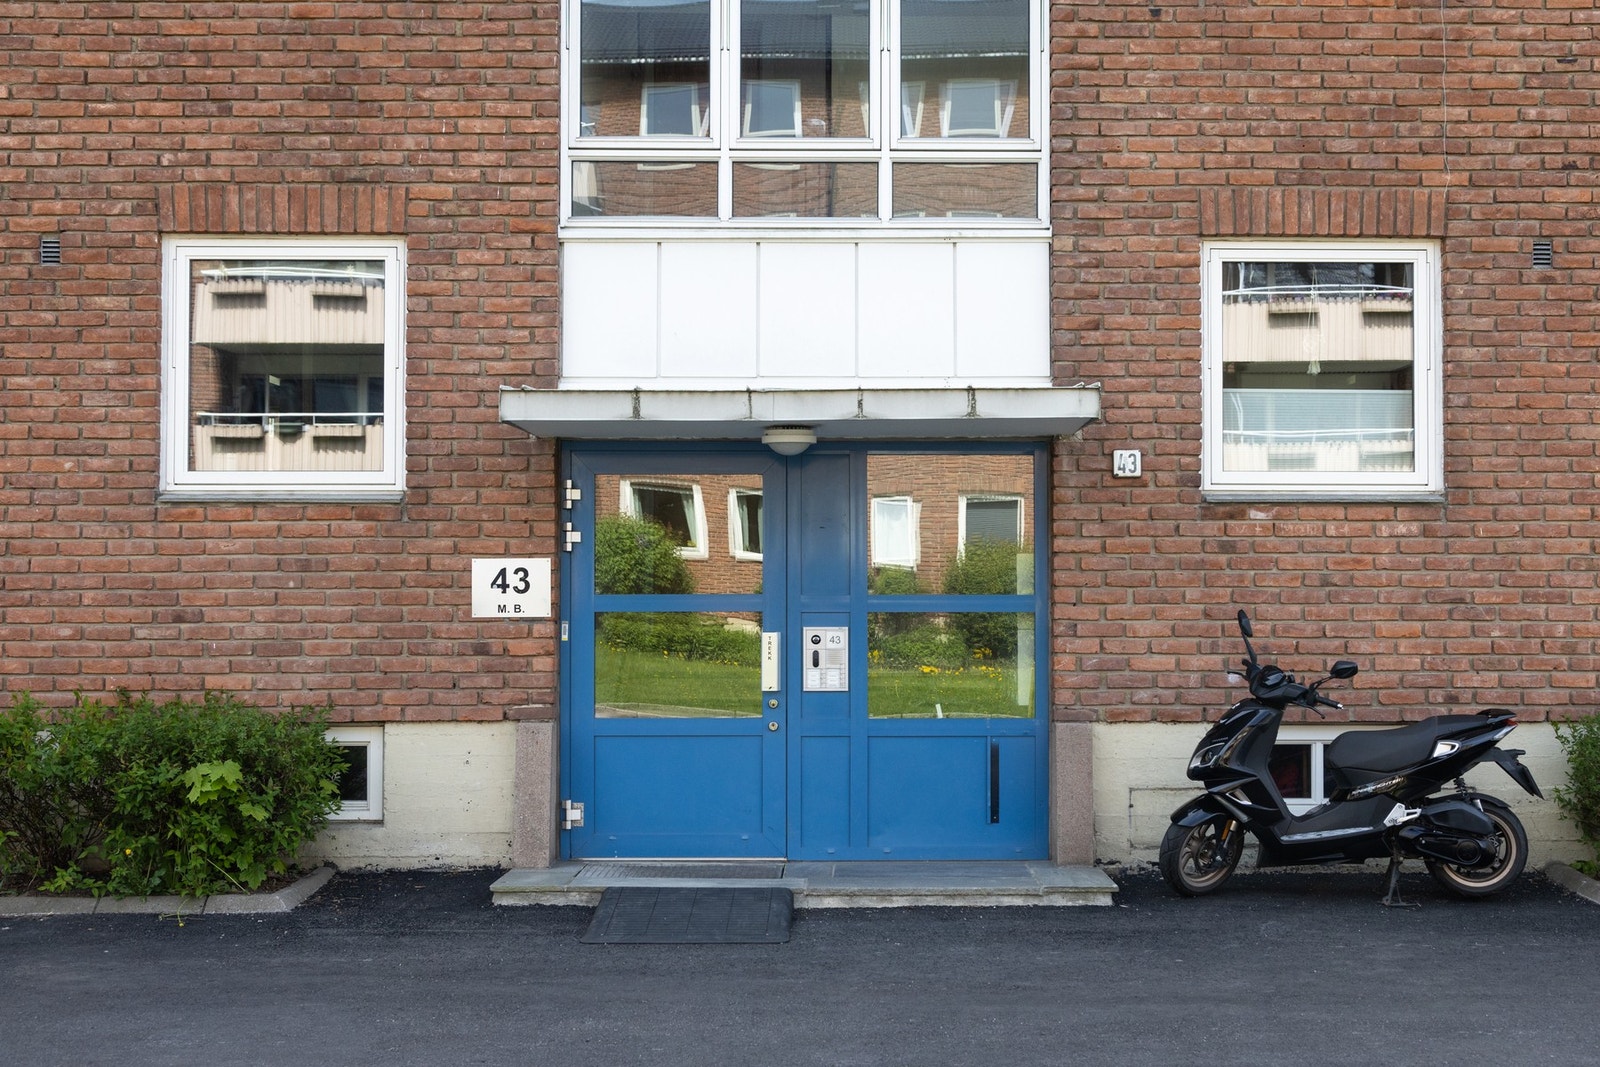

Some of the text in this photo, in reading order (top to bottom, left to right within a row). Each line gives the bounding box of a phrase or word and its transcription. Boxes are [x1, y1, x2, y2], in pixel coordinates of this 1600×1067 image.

[1117, 453, 1137, 473] 43
[490, 567, 531, 594] 43
[497, 604, 525, 614] M. B.
[829, 635, 841, 645] 43
